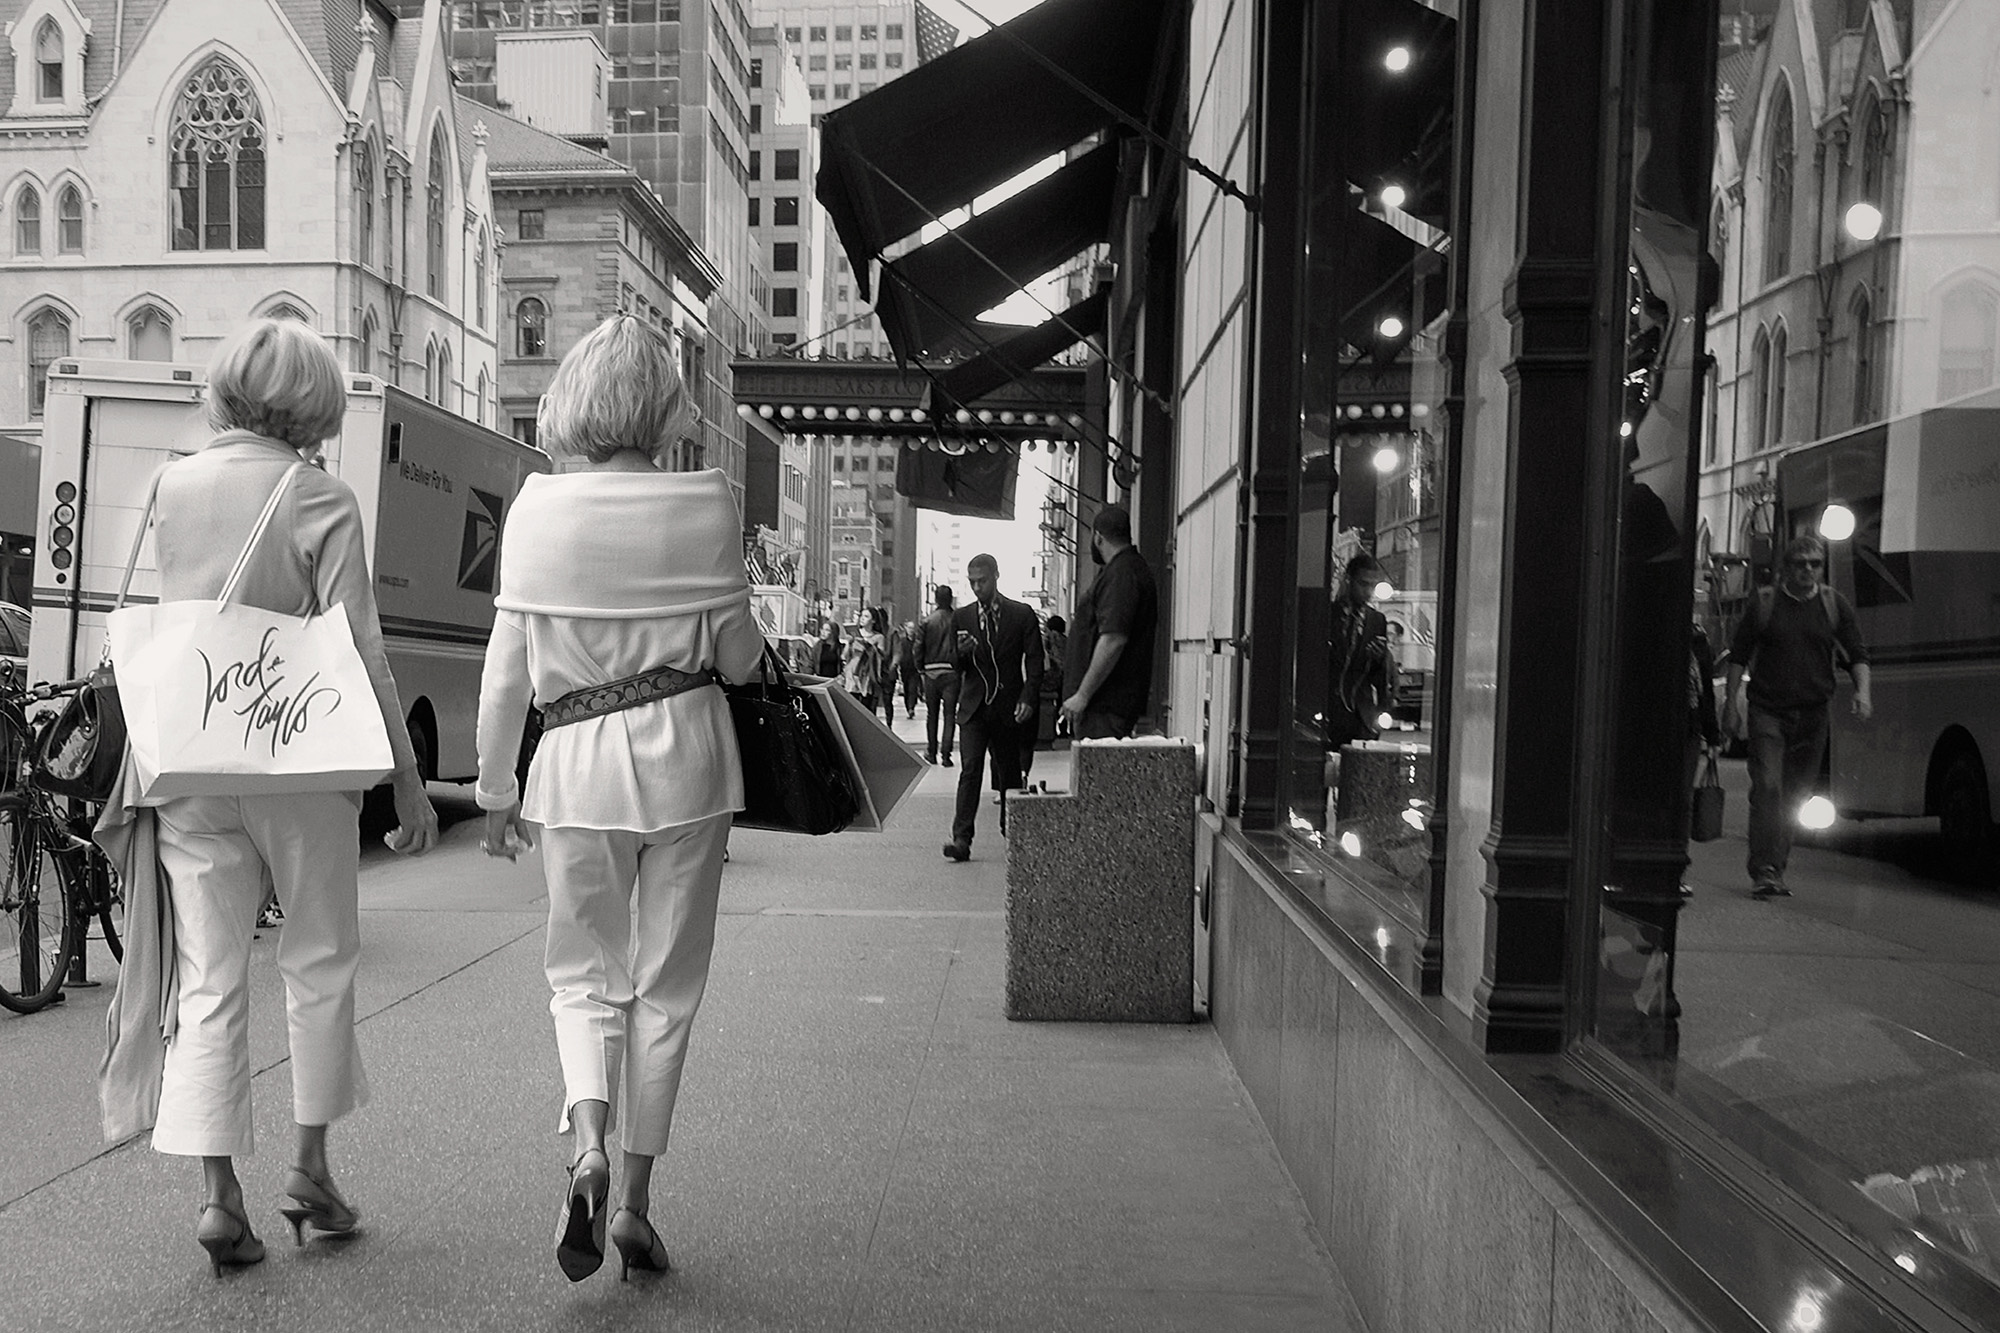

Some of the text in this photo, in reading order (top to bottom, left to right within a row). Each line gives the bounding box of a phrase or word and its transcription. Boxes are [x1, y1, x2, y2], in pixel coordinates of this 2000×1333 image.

[835, 378, 875, 395] SAKS
[410, 462, 431, 486] Deliver
[431, 469, 442, 490] For
[195, 626, 279, 731] Lord
[233, 671, 342, 758] Taylor
